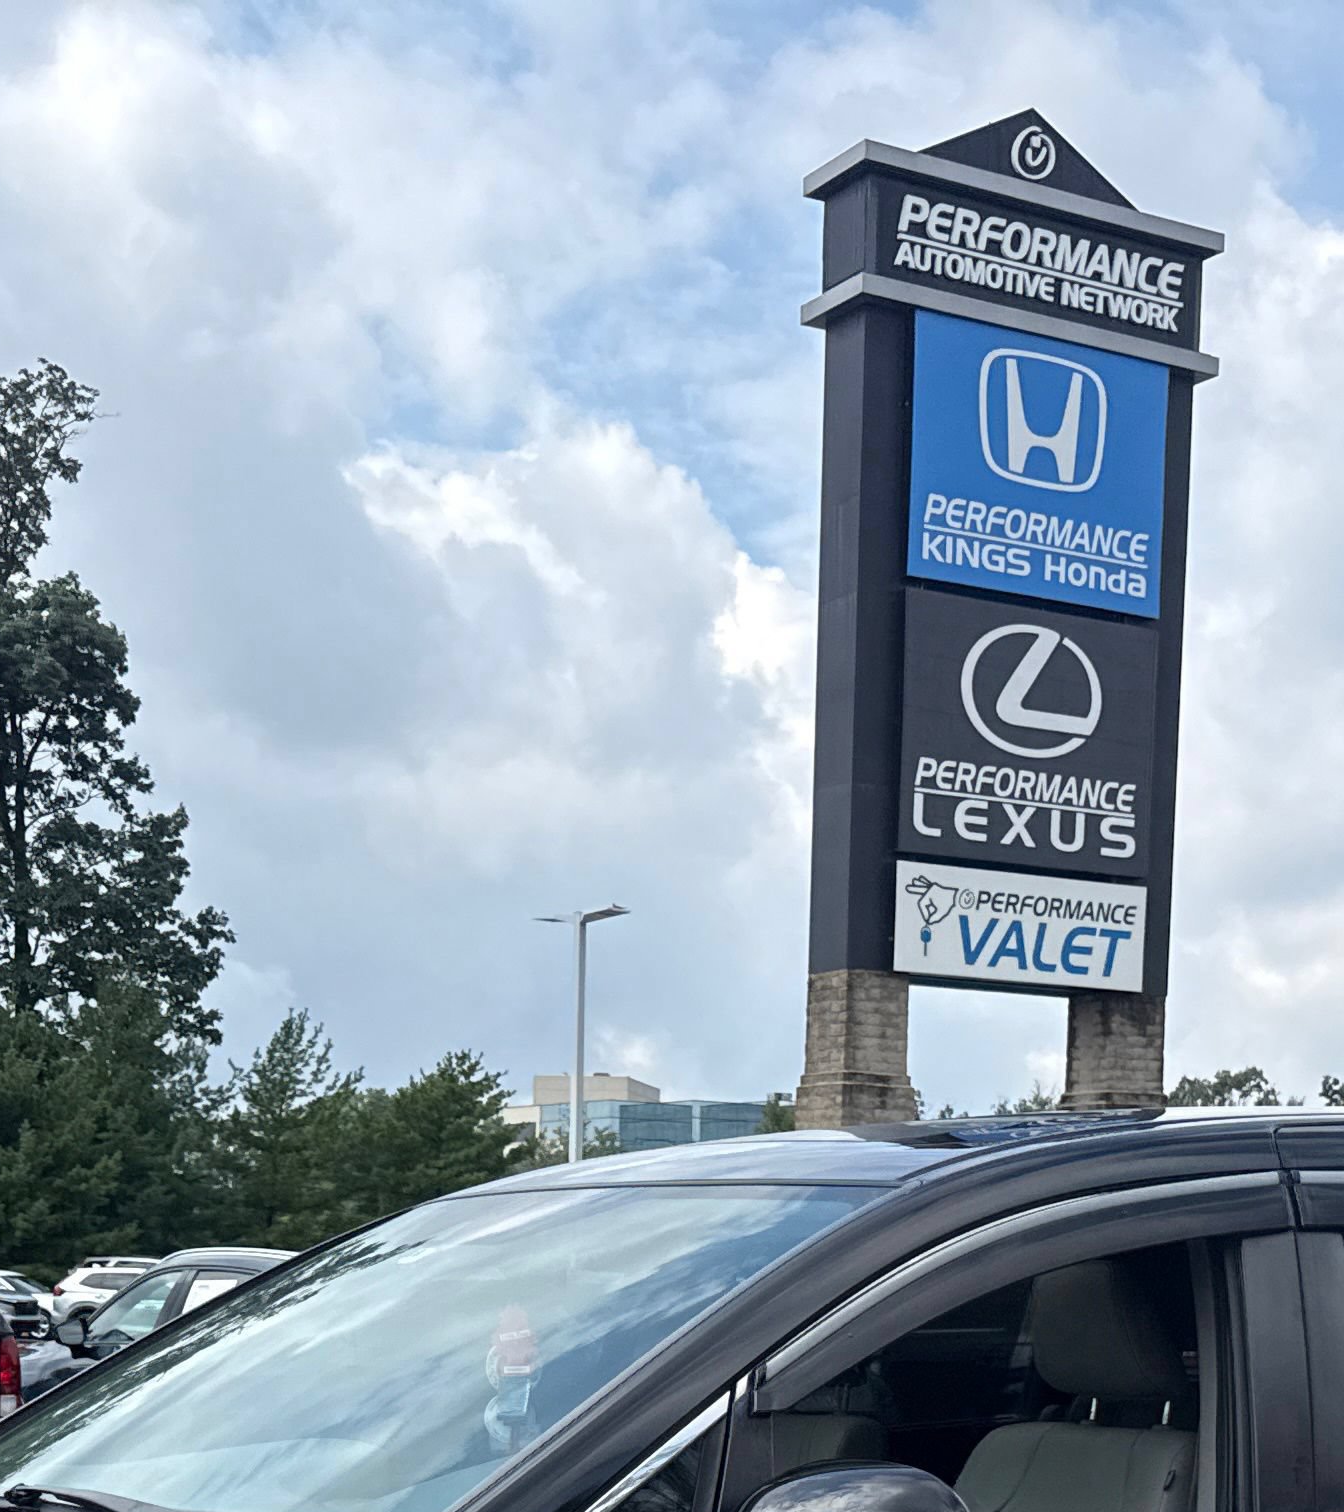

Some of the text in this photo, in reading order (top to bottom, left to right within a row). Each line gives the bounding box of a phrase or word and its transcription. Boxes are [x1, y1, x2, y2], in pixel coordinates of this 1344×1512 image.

[897, 193, 1185, 300] PERFORMANCE
[894, 242, 1178, 332] AUTOMOTIVE NETWORK
[923, 493, 1150, 562] PERFORMANCE
[921, 531, 1147, 598] KINGS Honda
[914, 756, 1137, 813] PERFORMANCE
[913, 793, 1136, 859] LEXUS
[975, 890, 1137, 925] PERFORMANCE
[958, 914, 1132, 978] VALET
